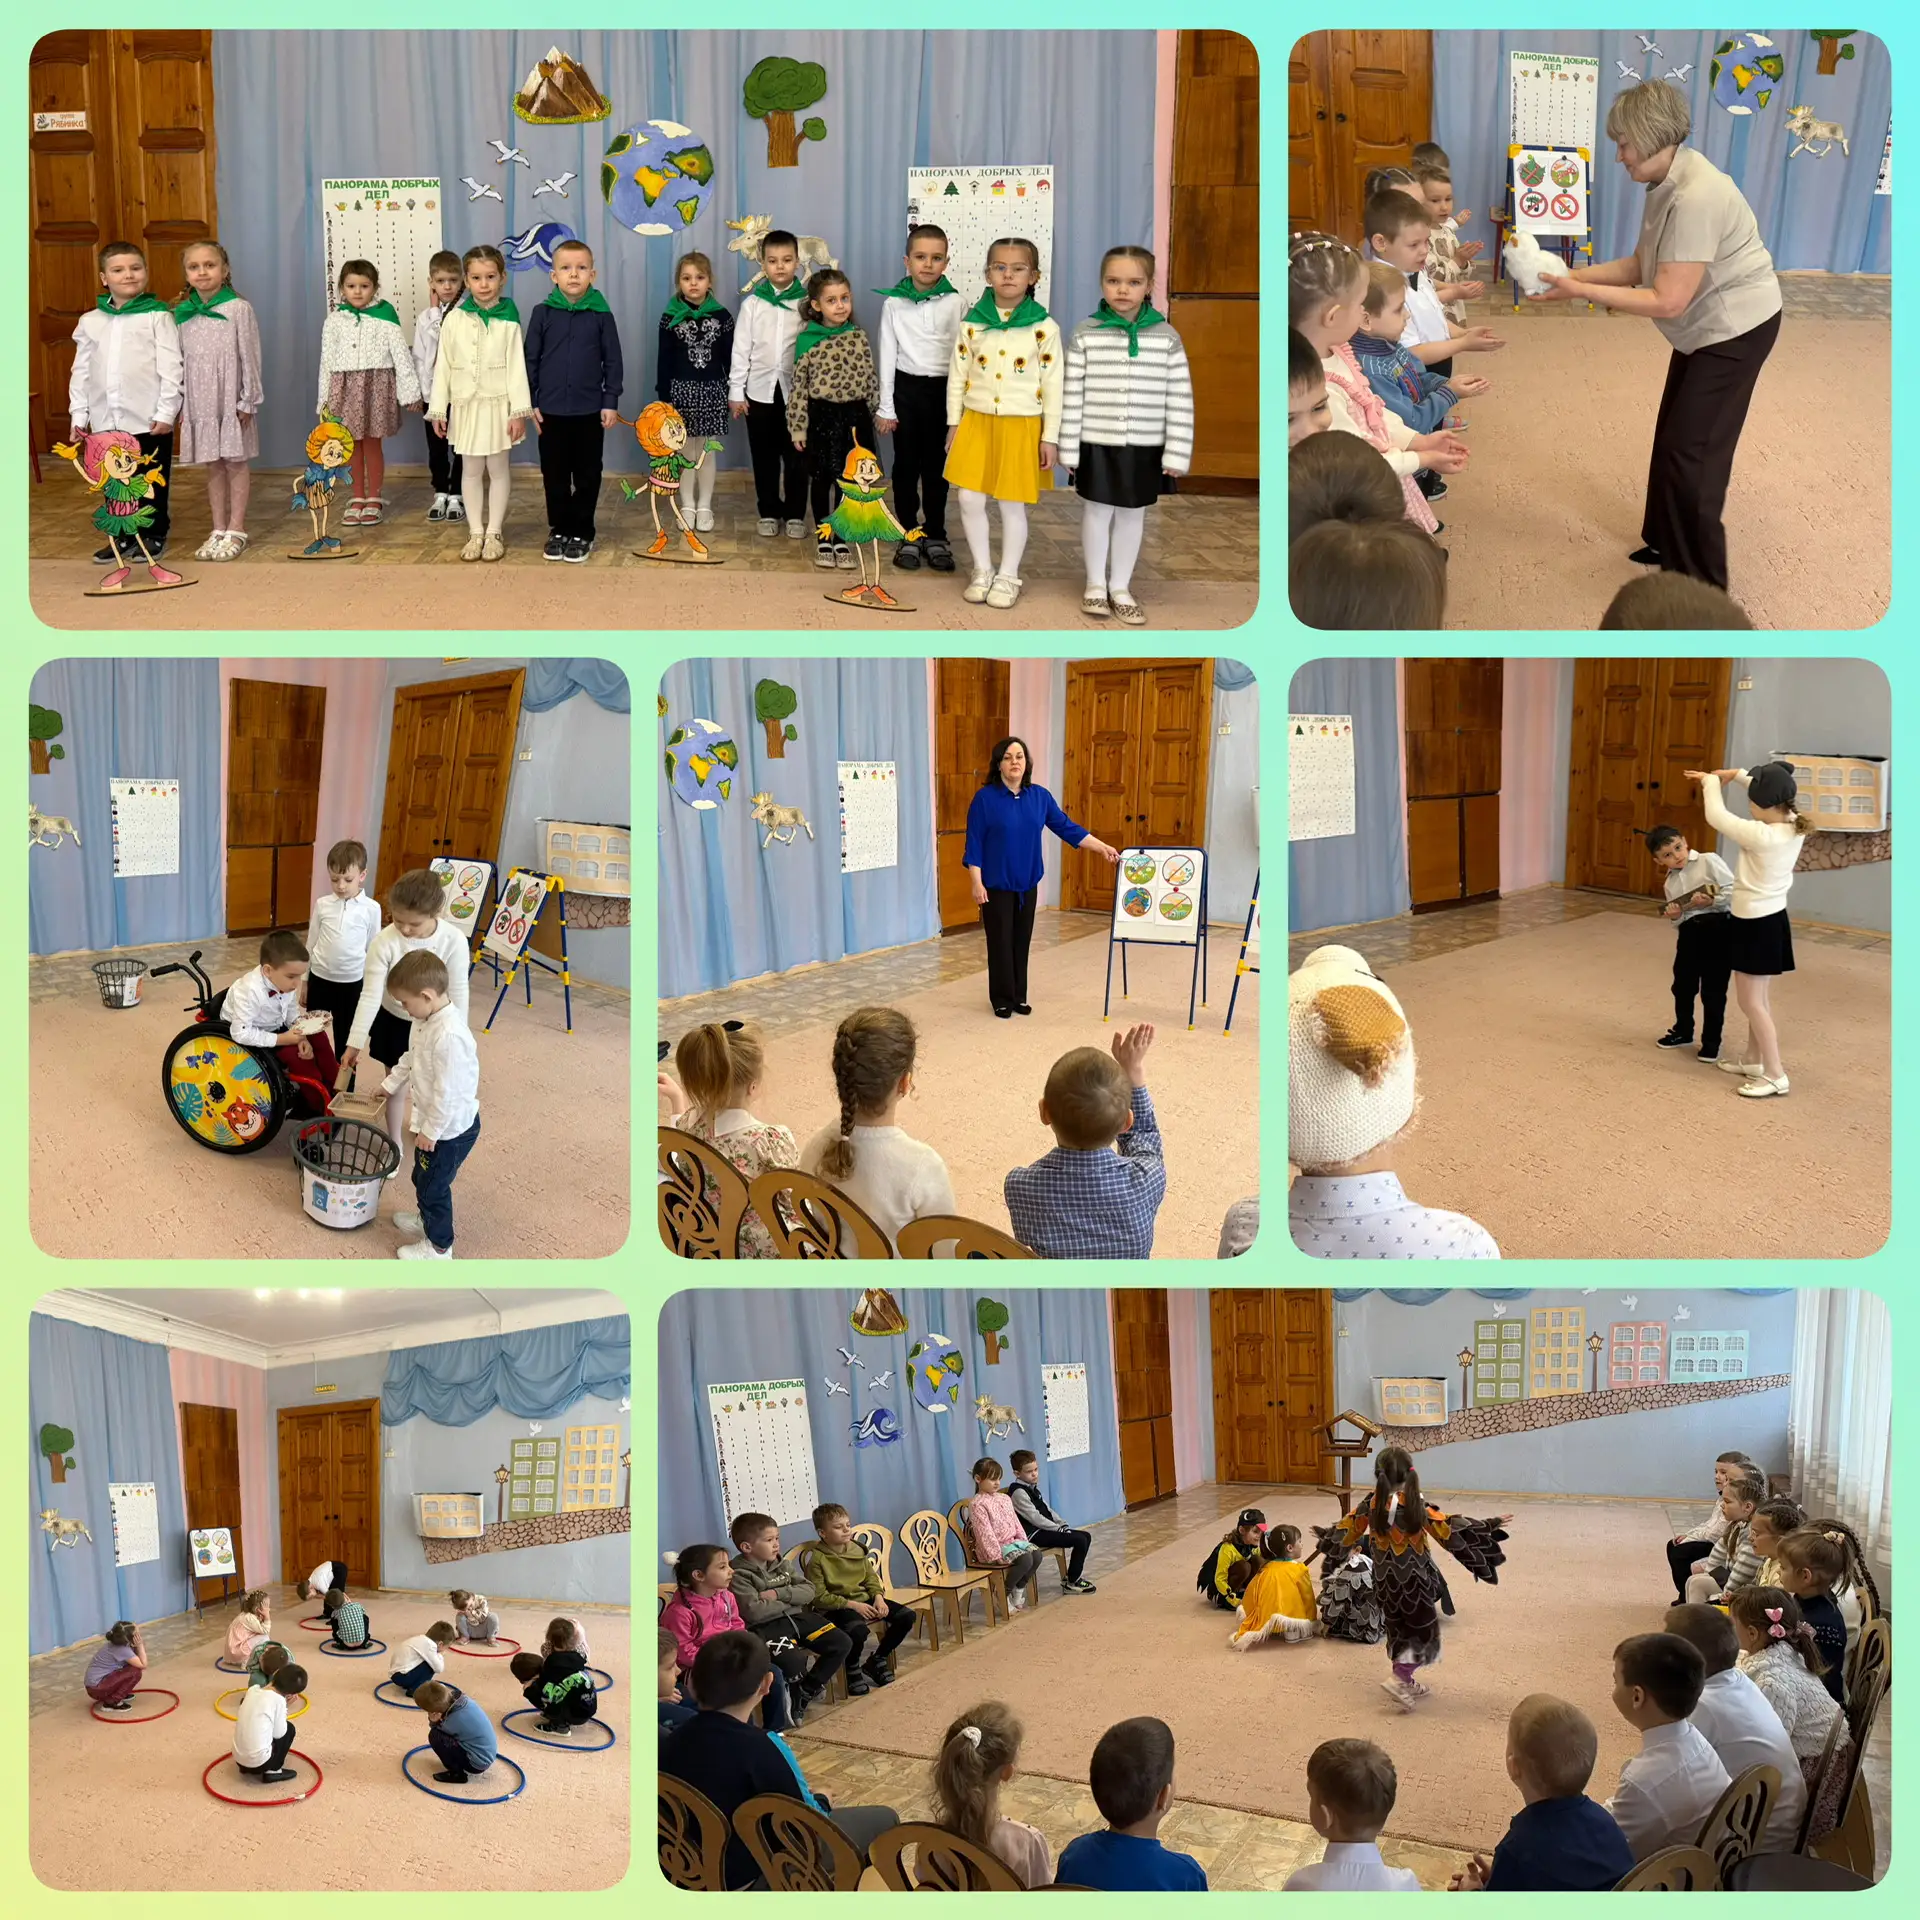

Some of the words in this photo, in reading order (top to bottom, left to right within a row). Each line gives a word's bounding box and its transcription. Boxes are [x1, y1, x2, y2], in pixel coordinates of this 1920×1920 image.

[1513, 53, 1561, 63] ПАНОРАМА
[1563, 56, 1599, 66] ДОБРЫХ
[1543, 63, 1561, 71] ДЕЛ
[910, 168, 971, 178] ПАНОРАМА
[977, 168, 1023, 178] ДОБРЫХ
[1028, 167, 1050, 176] ДЕЛ
[324, 180, 388, 190] ПАНОРАМА
[391, 179, 440, 190] ДОБРЫХ
[364, 190, 390, 200] ДЕЛ
[710, 1382, 766, 1394] ПАНОРАМА
[768, 1380, 805, 1391] ДОБРЫХ
[746, 1392, 768, 1401] ДЕЛ
